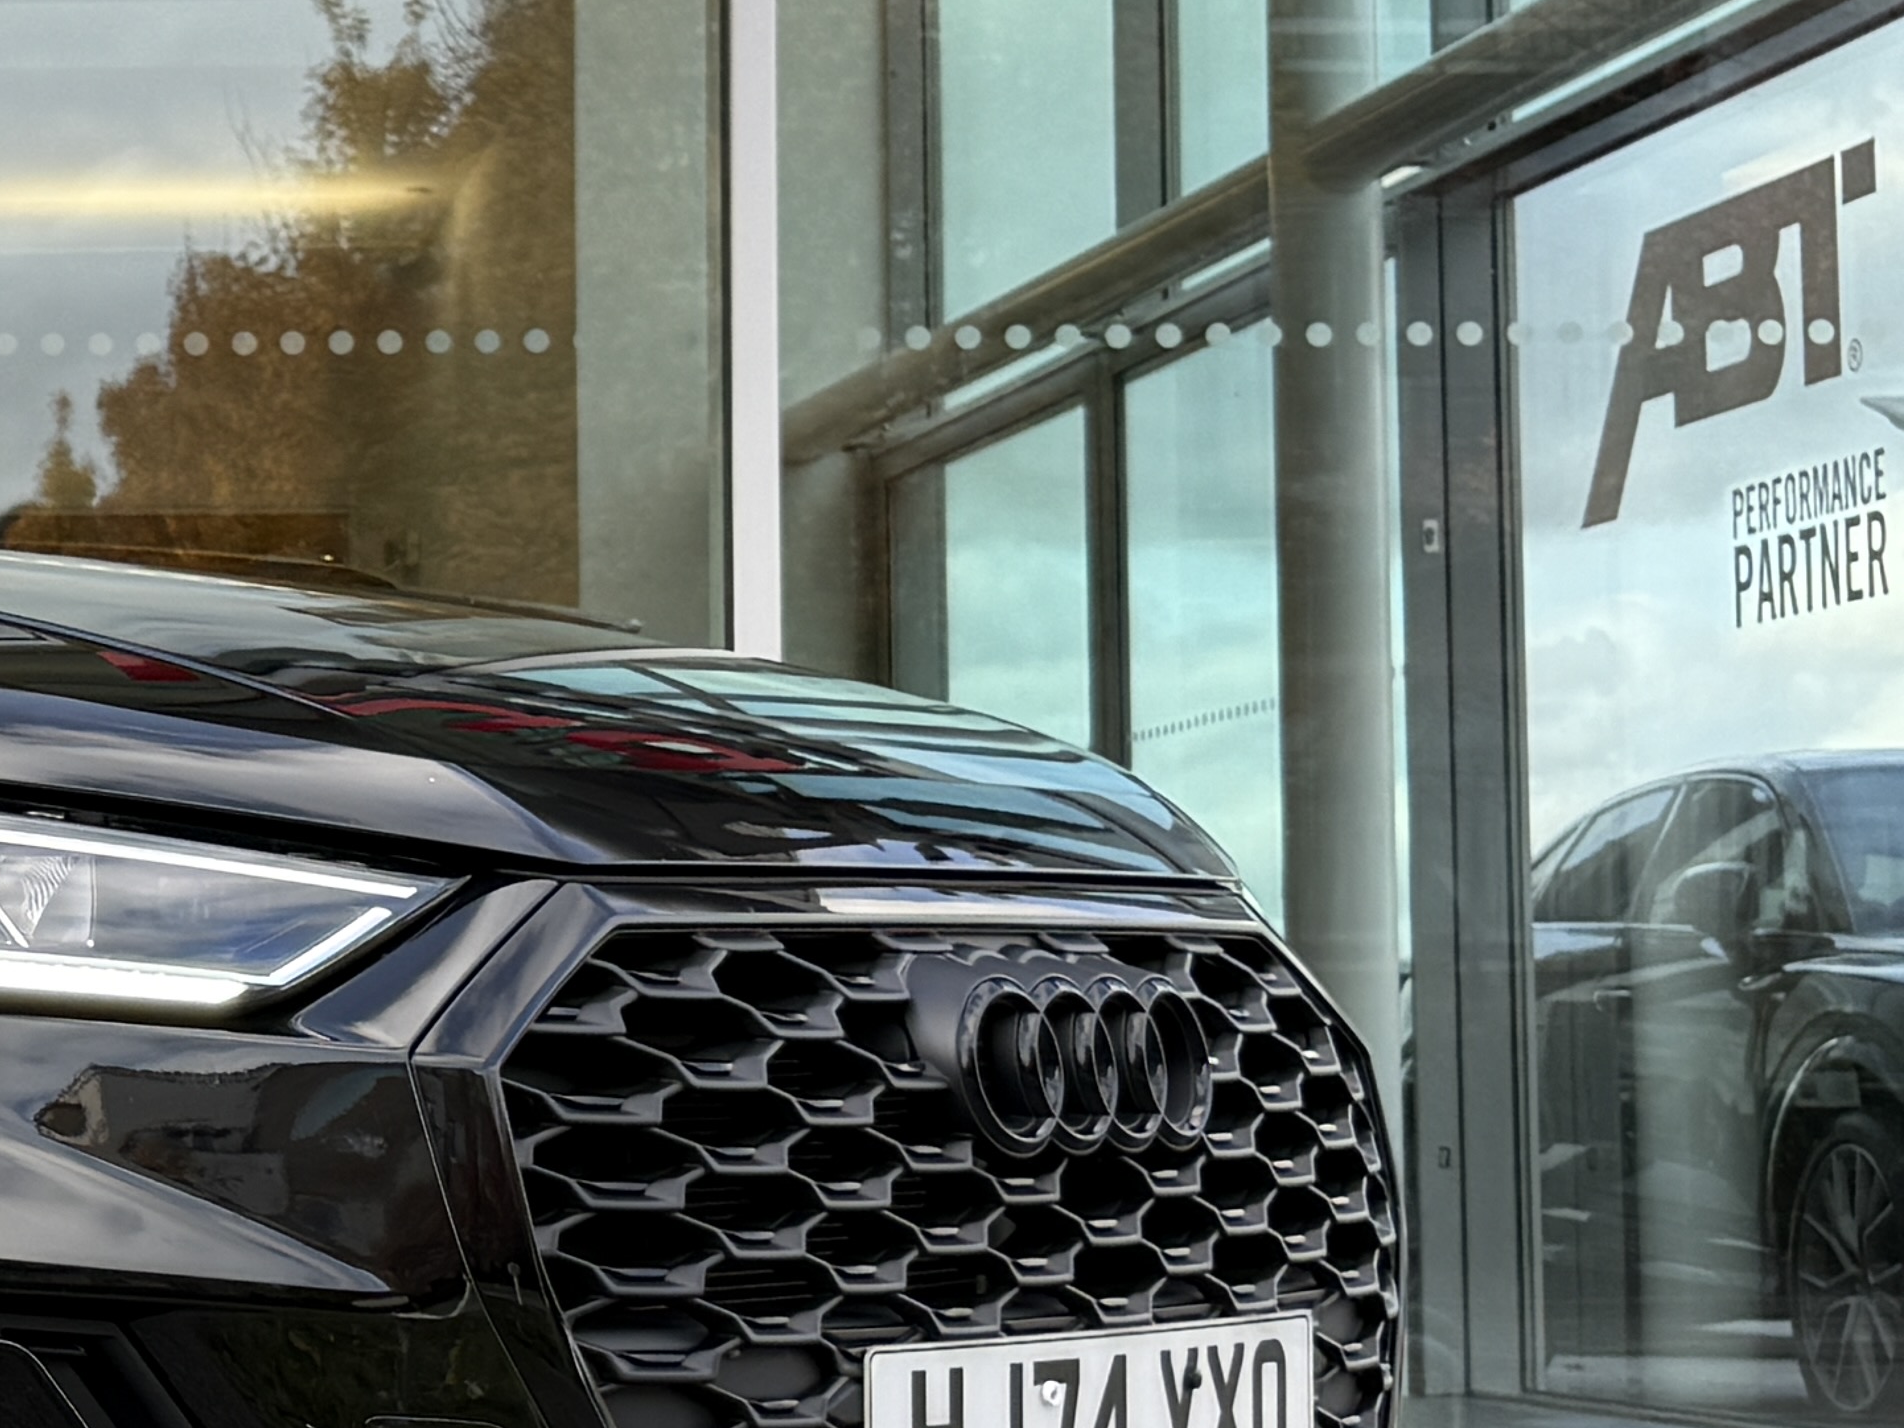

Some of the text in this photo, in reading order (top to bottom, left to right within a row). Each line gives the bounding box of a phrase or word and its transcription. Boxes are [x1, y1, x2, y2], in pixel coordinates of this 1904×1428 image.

[1579, 136, 1877, 530] ABT
[1730, 446, 1888, 540] PERFORMANCE
[1732, 510, 1890, 629] PARTNER
